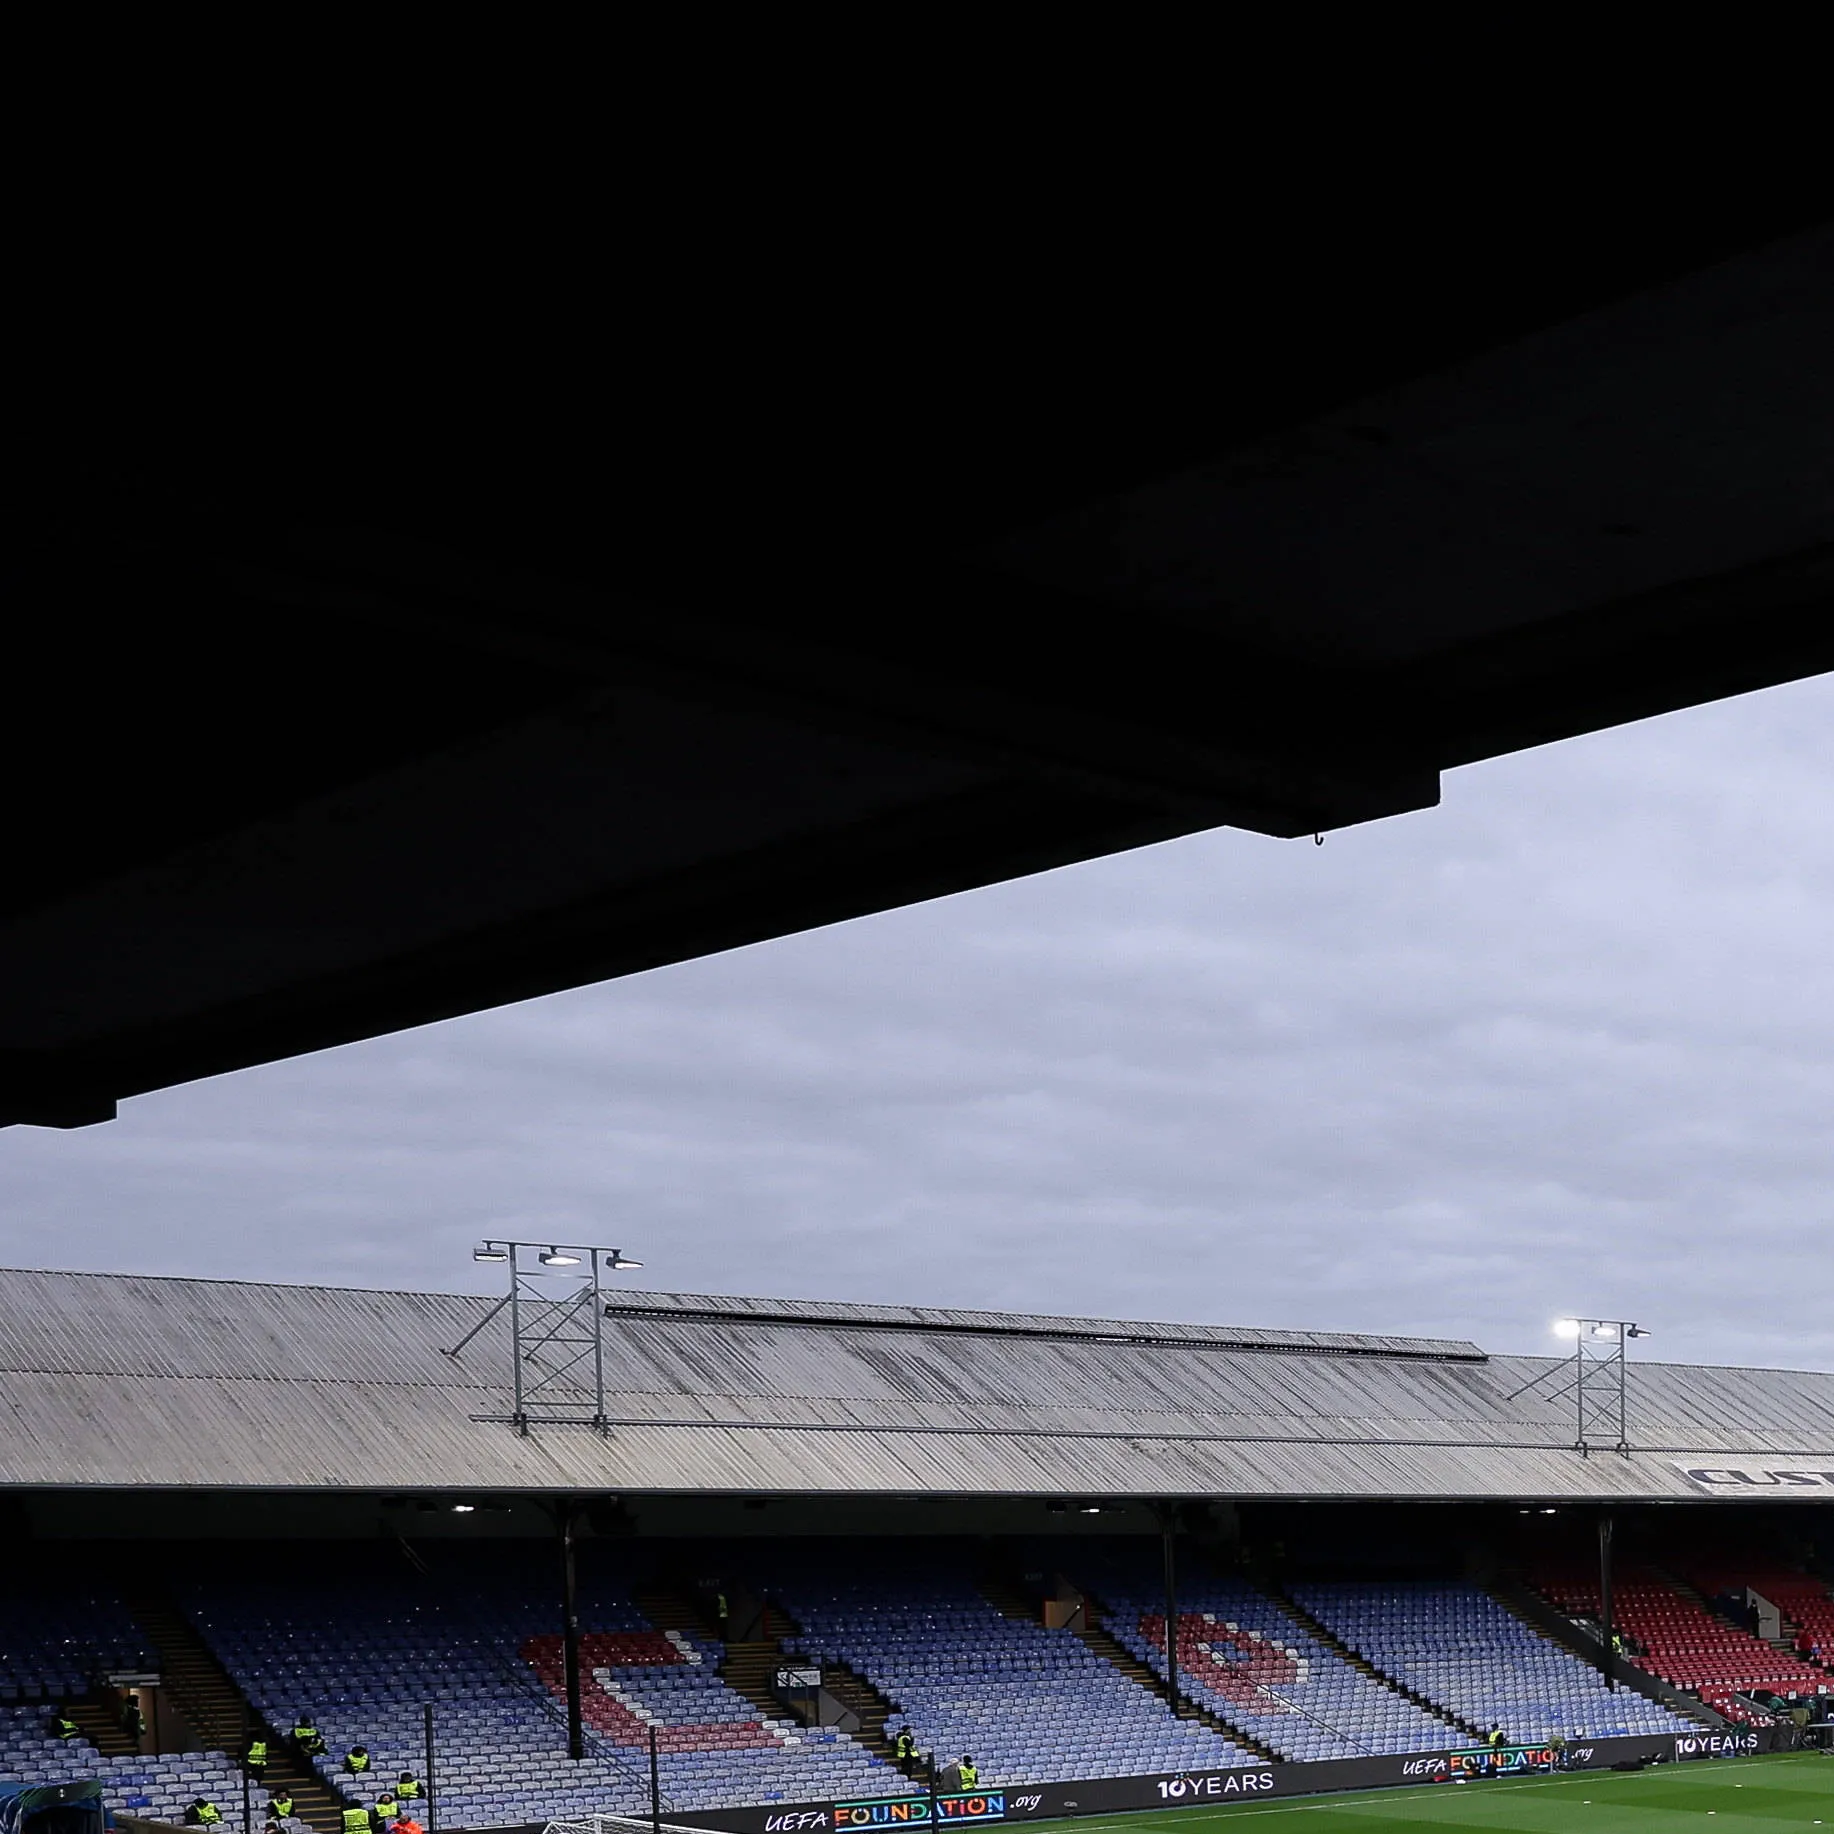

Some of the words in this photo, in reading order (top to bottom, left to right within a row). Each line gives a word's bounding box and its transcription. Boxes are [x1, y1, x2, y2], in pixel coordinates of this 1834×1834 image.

[1402, 1759, 1447, 1775] UEFA
[765, 1810, 829, 1832] UEFA
[834, 1796, 1004, 1826] FOUNDATION
[1010, 1793, 1042, 1811] .org
